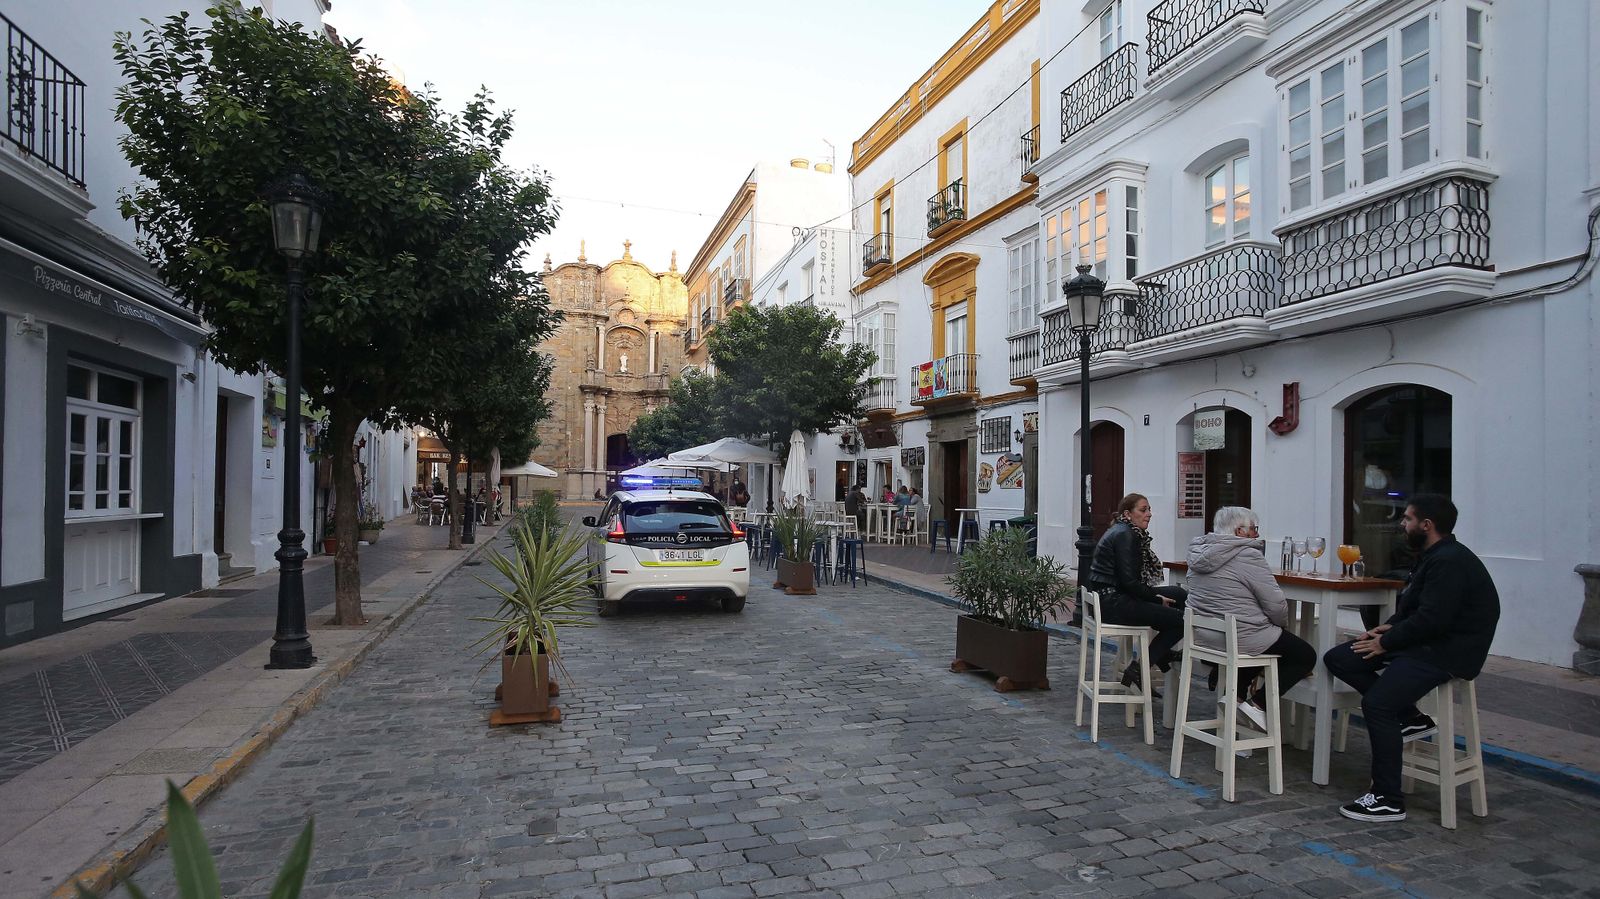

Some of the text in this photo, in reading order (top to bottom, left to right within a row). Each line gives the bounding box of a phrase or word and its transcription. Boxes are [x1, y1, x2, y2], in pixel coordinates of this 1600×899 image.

[73, 284, 102, 306] Central
[1195, 416, 1223, 429] BOHO
[687, 550, 703, 559] LGL
